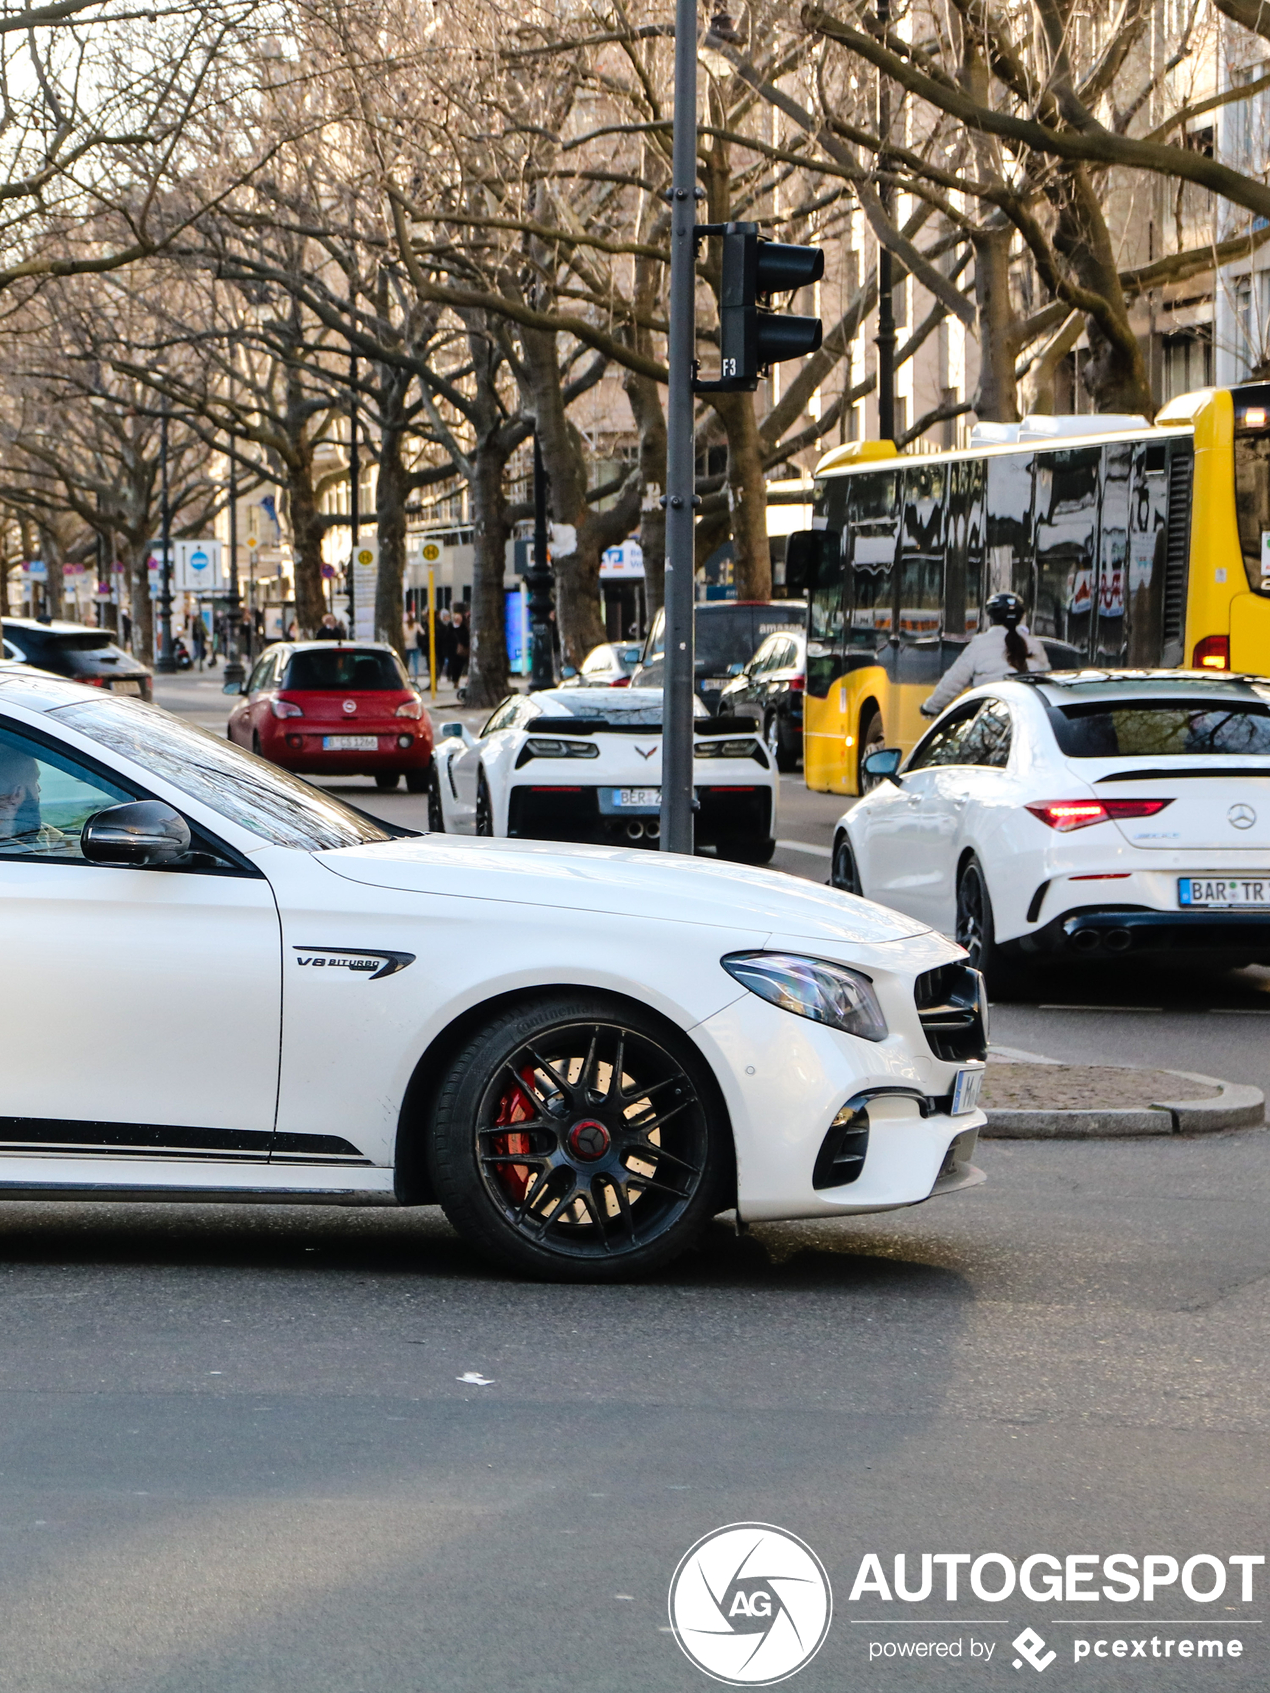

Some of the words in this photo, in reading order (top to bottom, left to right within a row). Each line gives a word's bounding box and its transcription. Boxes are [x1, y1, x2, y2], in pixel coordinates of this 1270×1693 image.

[722, 357, 736, 377] F3
[621, 792, 646, 805] BER
[1192, 882, 1227, 900] BAR
[1242, 882, 1264, 900] TR
[296, 957, 326, 967] V8
[327, 959, 380, 967] BITURBO
